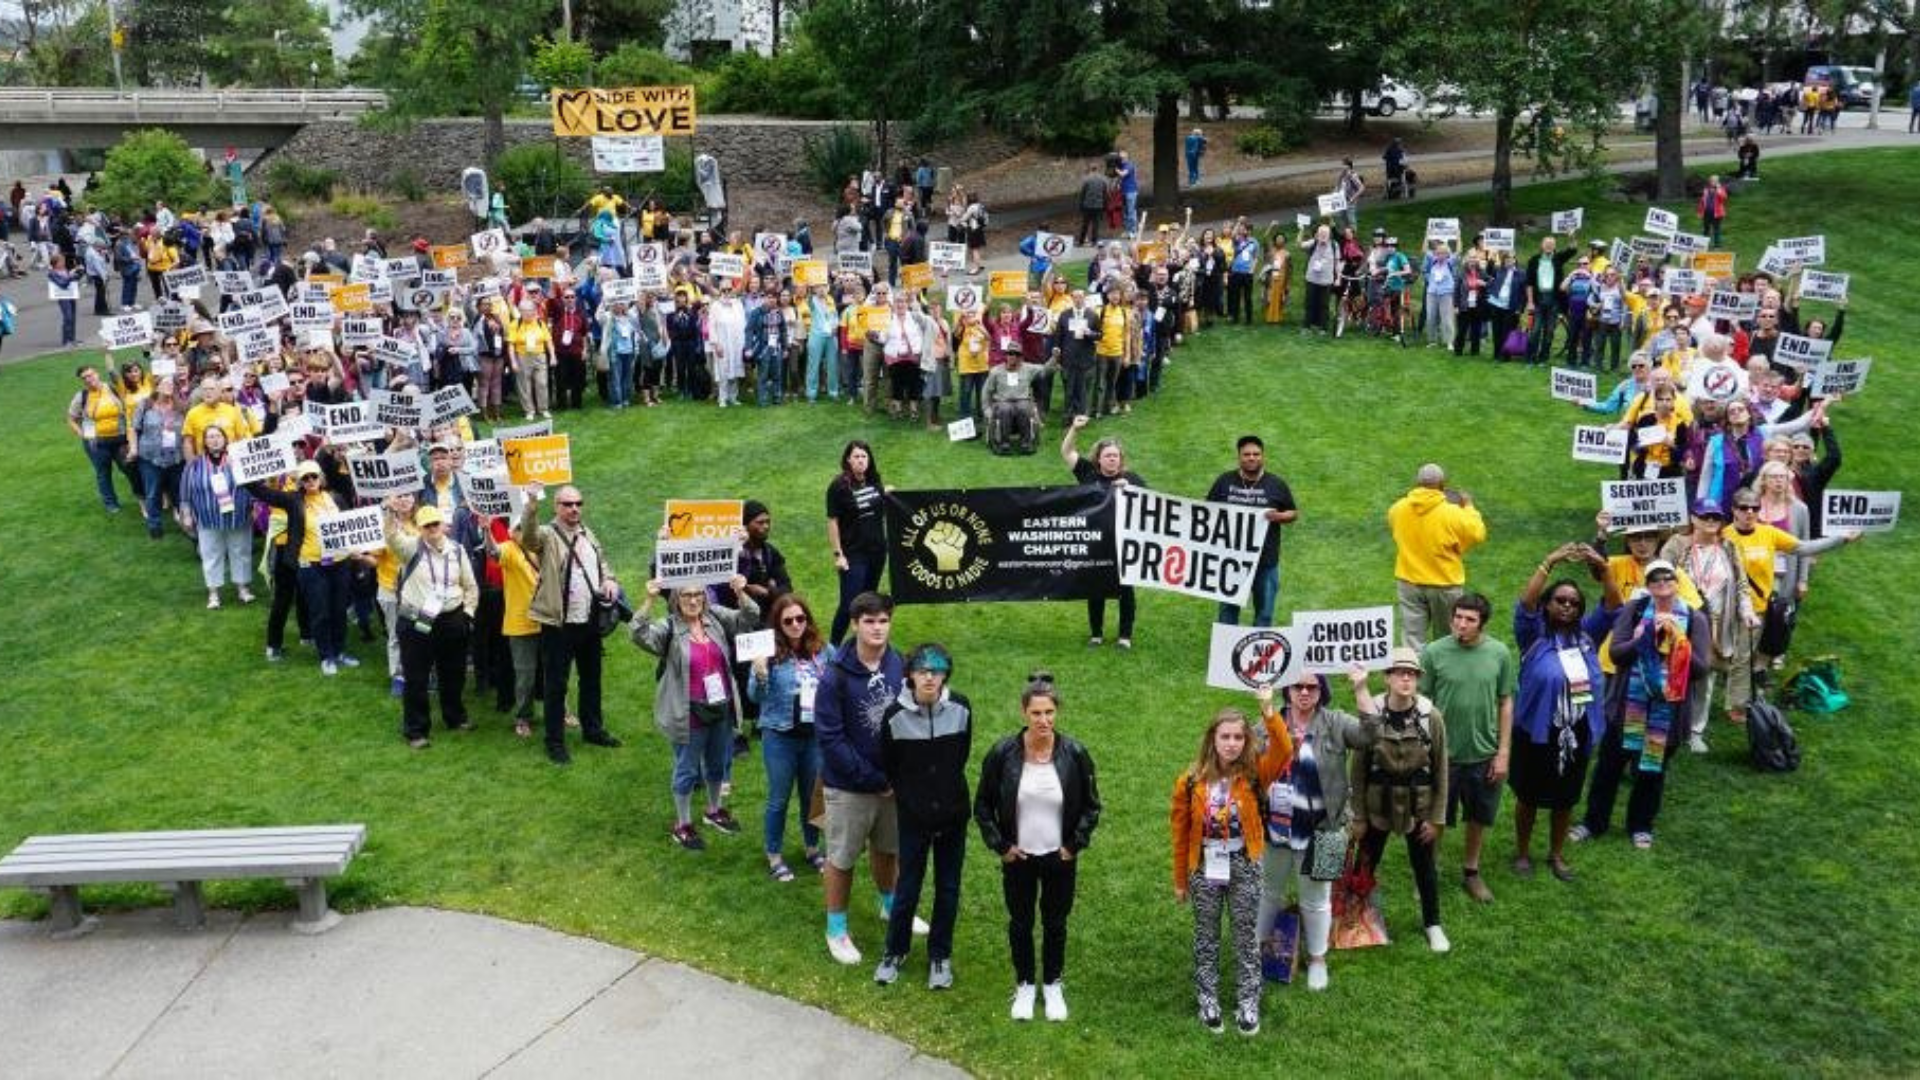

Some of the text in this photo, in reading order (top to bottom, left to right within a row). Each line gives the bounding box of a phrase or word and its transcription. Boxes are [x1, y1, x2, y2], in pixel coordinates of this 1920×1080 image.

[595, 88, 690, 104] SIDE WITH
[596, 107, 691, 132] LOVE
[1712, 292, 1740, 308] END
[293, 306, 316, 318] END
[221, 313, 246, 329] END
[344, 322, 367, 333] END
[1782, 336, 1811, 354] END
[390, 393, 413, 405] END
[329, 406, 361, 426] END
[377, 412, 420, 426] RACISM
[1578, 429, 1605, 445] END
[247, 438, 270, 454] END
[240, 448, 283, 467] SYSTEMIC
[243, 458, 286, 479] RACISM
[352, 459, 390, 479] END
[524, 457, 569, 476] LOVE
[471, 478, 495, 491] END
[1610, 481, 1677, 499] SERVICES
[1632, 499, 1657, 512] NOT
[1828, 495, 1868, 515] END
[320, 514, 379, 536] SCHOOLS
[901, 502, 993, 551] ALL OF US OR NONE
[1023, 516, 1087, 528] EASTERN
[1122, 489, 1261, 554] THE BAIL
[1612, 511, 1682, 526] SENTENCES
[323, 528, 384, 549] NOT CELLS
[1008, 531, 1103, 542] WASHINGTON
[661, 548, 733, 565] WE DESERVE
[1023, 544, 1089, 555] CHAPTER
[661, 561, 733, 577] SMART JUSTICE
[907, 556, 990, 589] TODOS O NADIE
[1308, 618, 1388, 642] CHOOLS
[1340, 641, 1388, 663] CELLS
